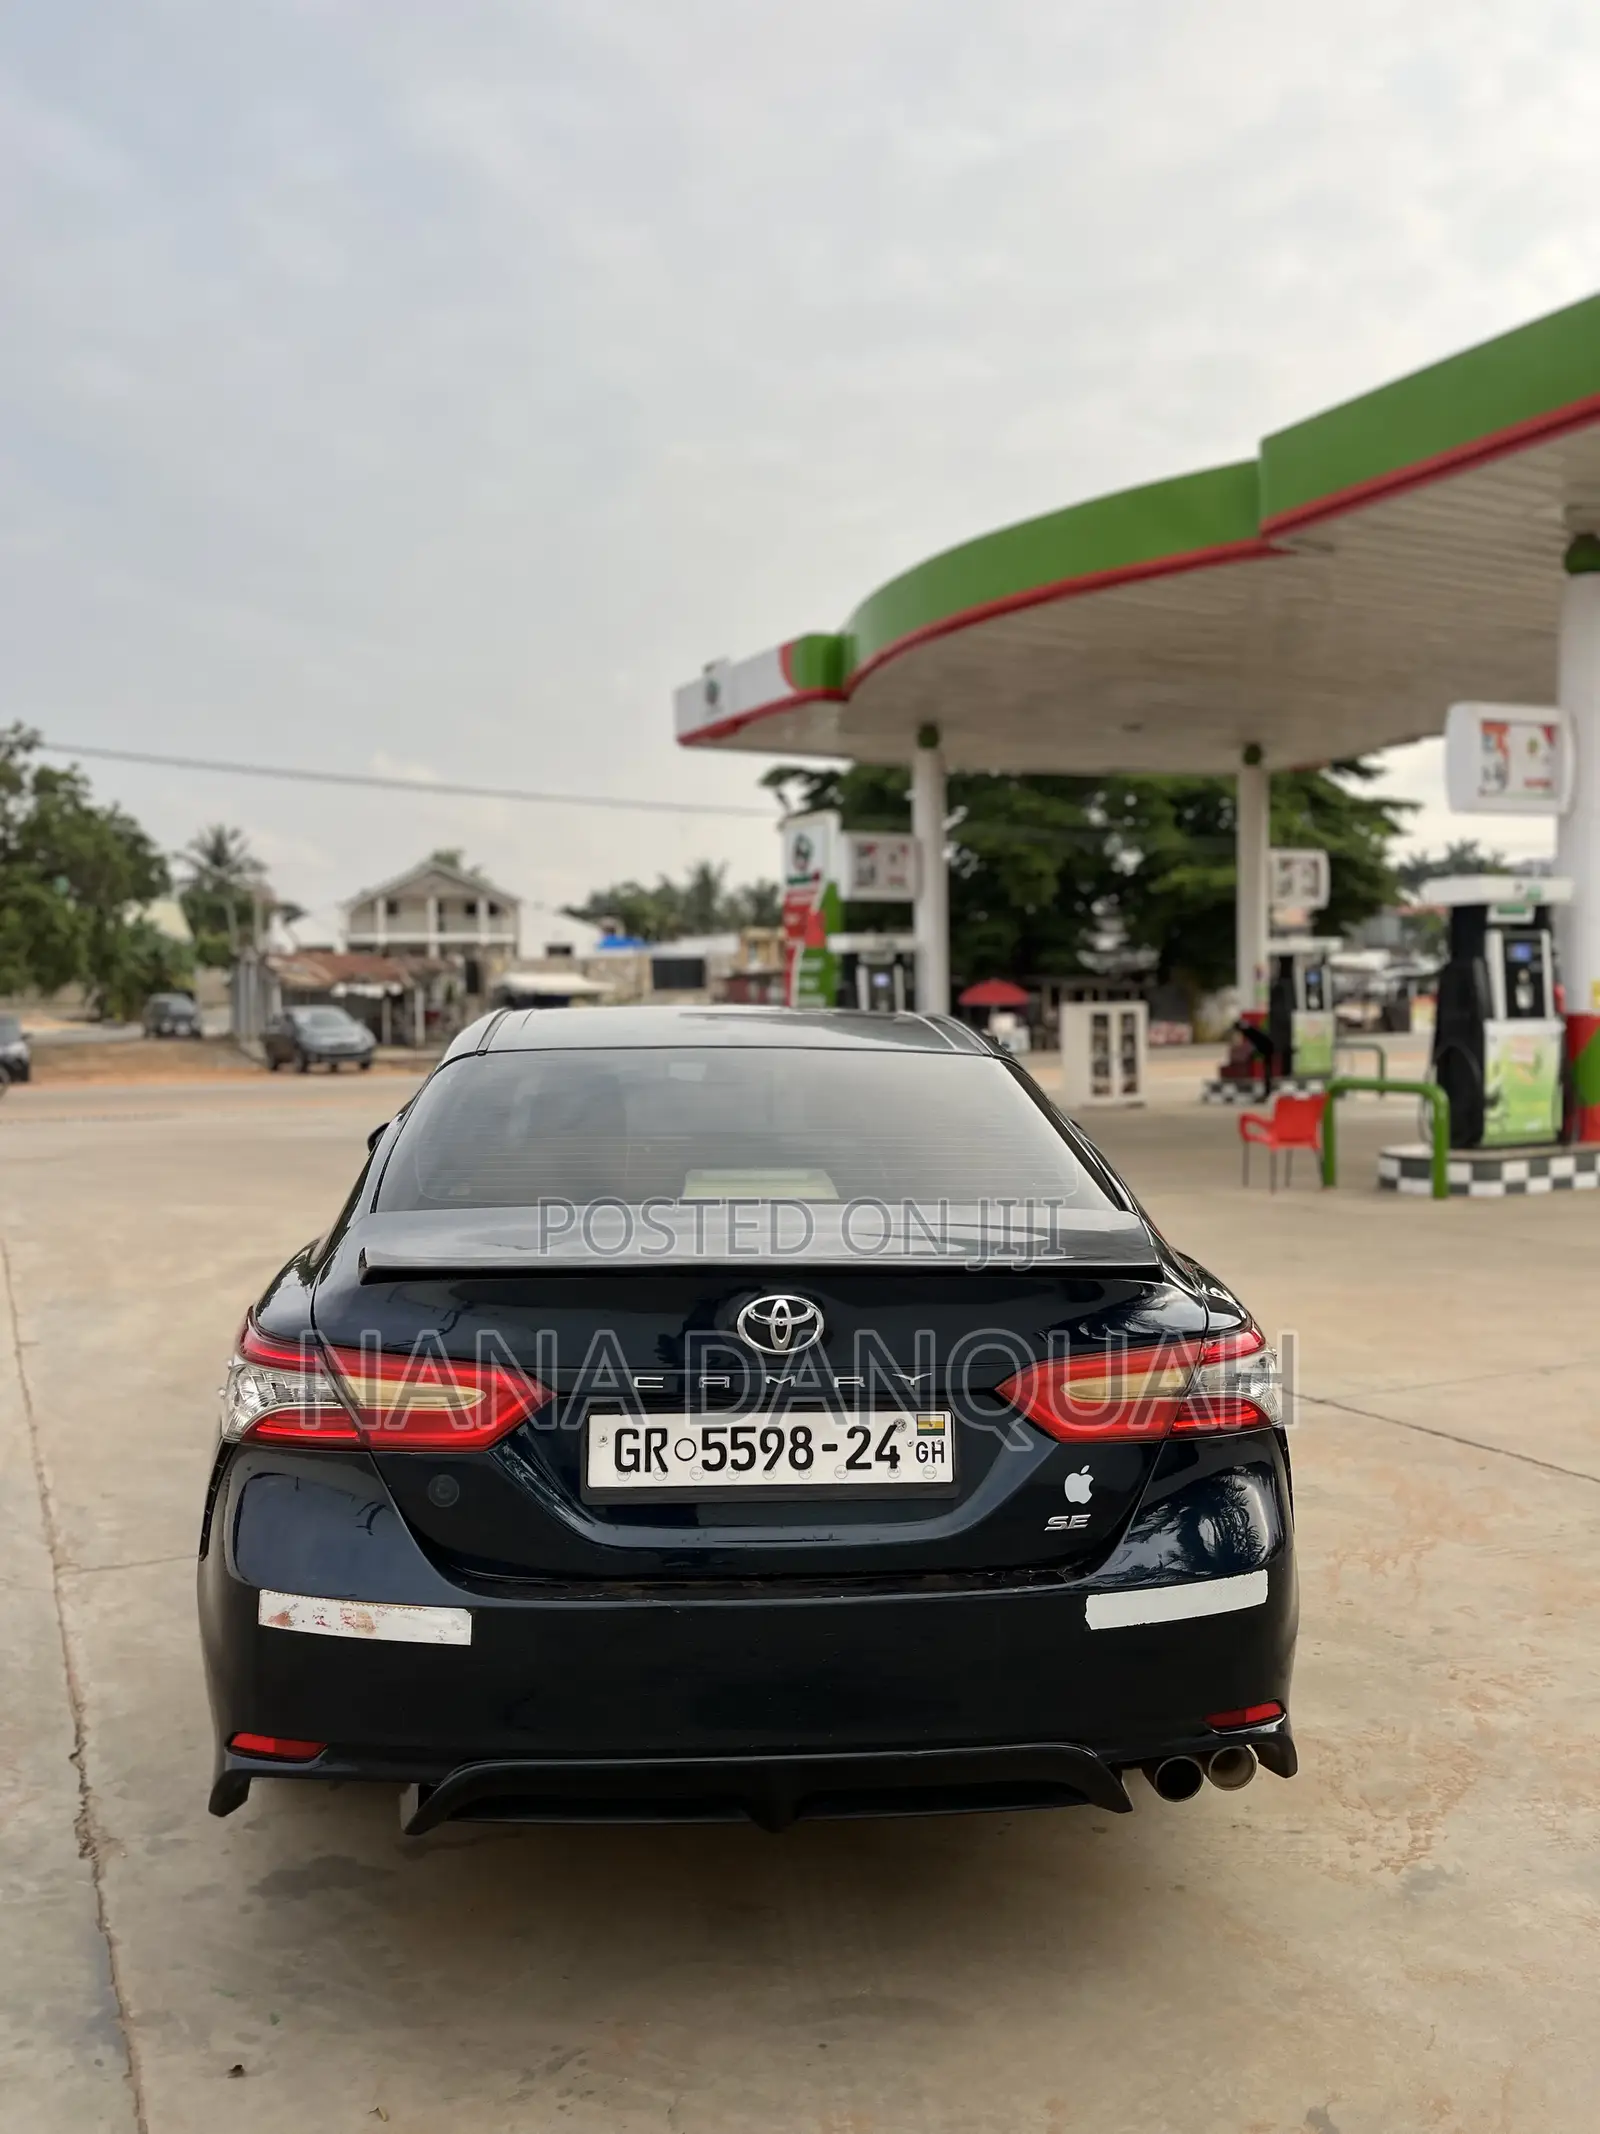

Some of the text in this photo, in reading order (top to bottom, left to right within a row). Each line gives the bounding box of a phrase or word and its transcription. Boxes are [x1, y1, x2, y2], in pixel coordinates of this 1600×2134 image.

[633, 1372, 933, 1389] CAMRY
[614, 1428, 669, 1473] GR
[915, 1441, 945, 1464] GH
[1044, 1513, 1092, 1532] SE
